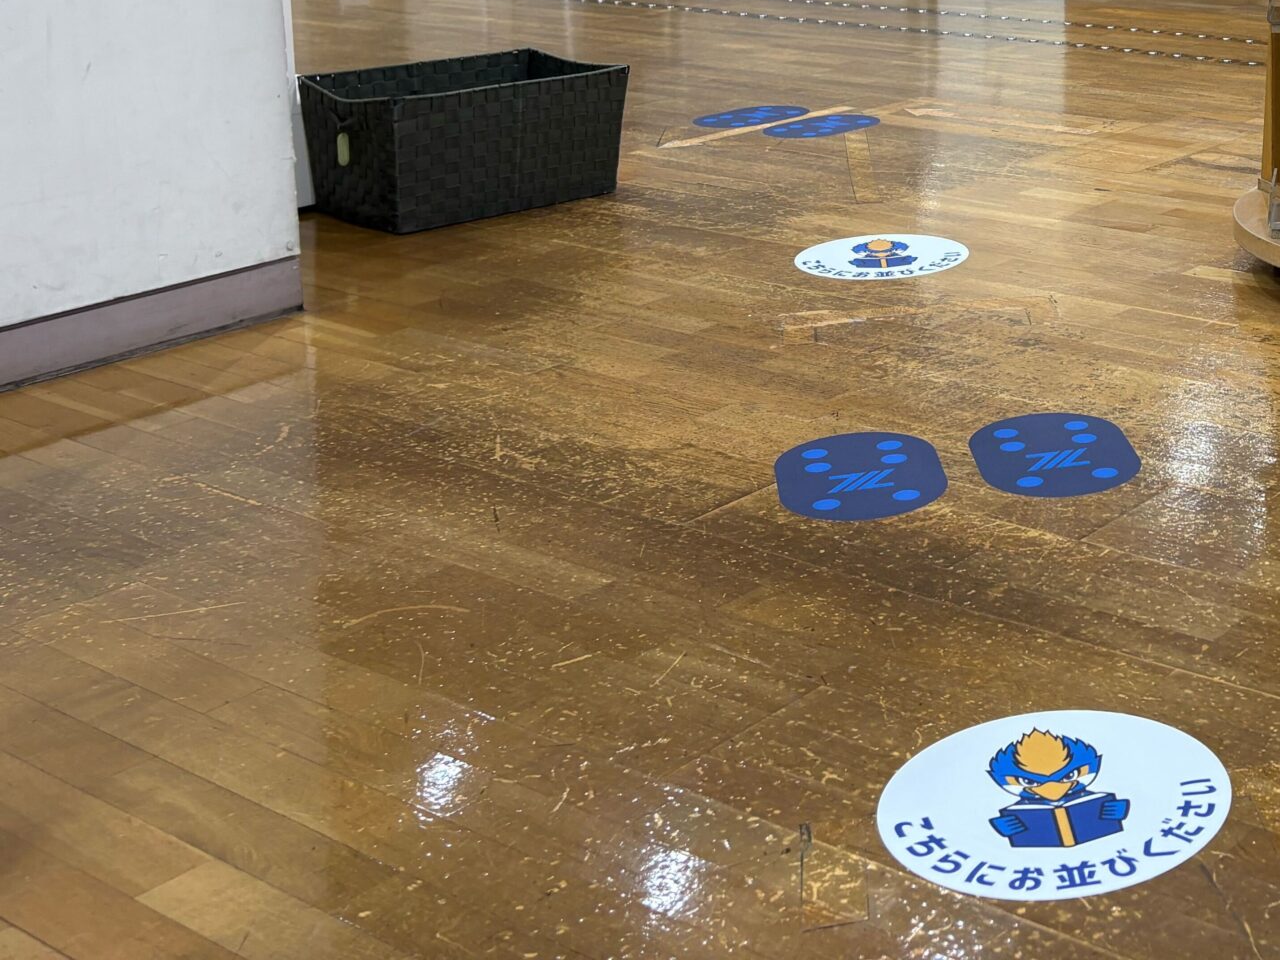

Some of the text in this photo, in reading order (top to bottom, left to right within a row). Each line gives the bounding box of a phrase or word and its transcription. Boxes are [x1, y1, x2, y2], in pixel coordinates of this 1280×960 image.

[893, 777, 1218, 892] こちらにお並びください
